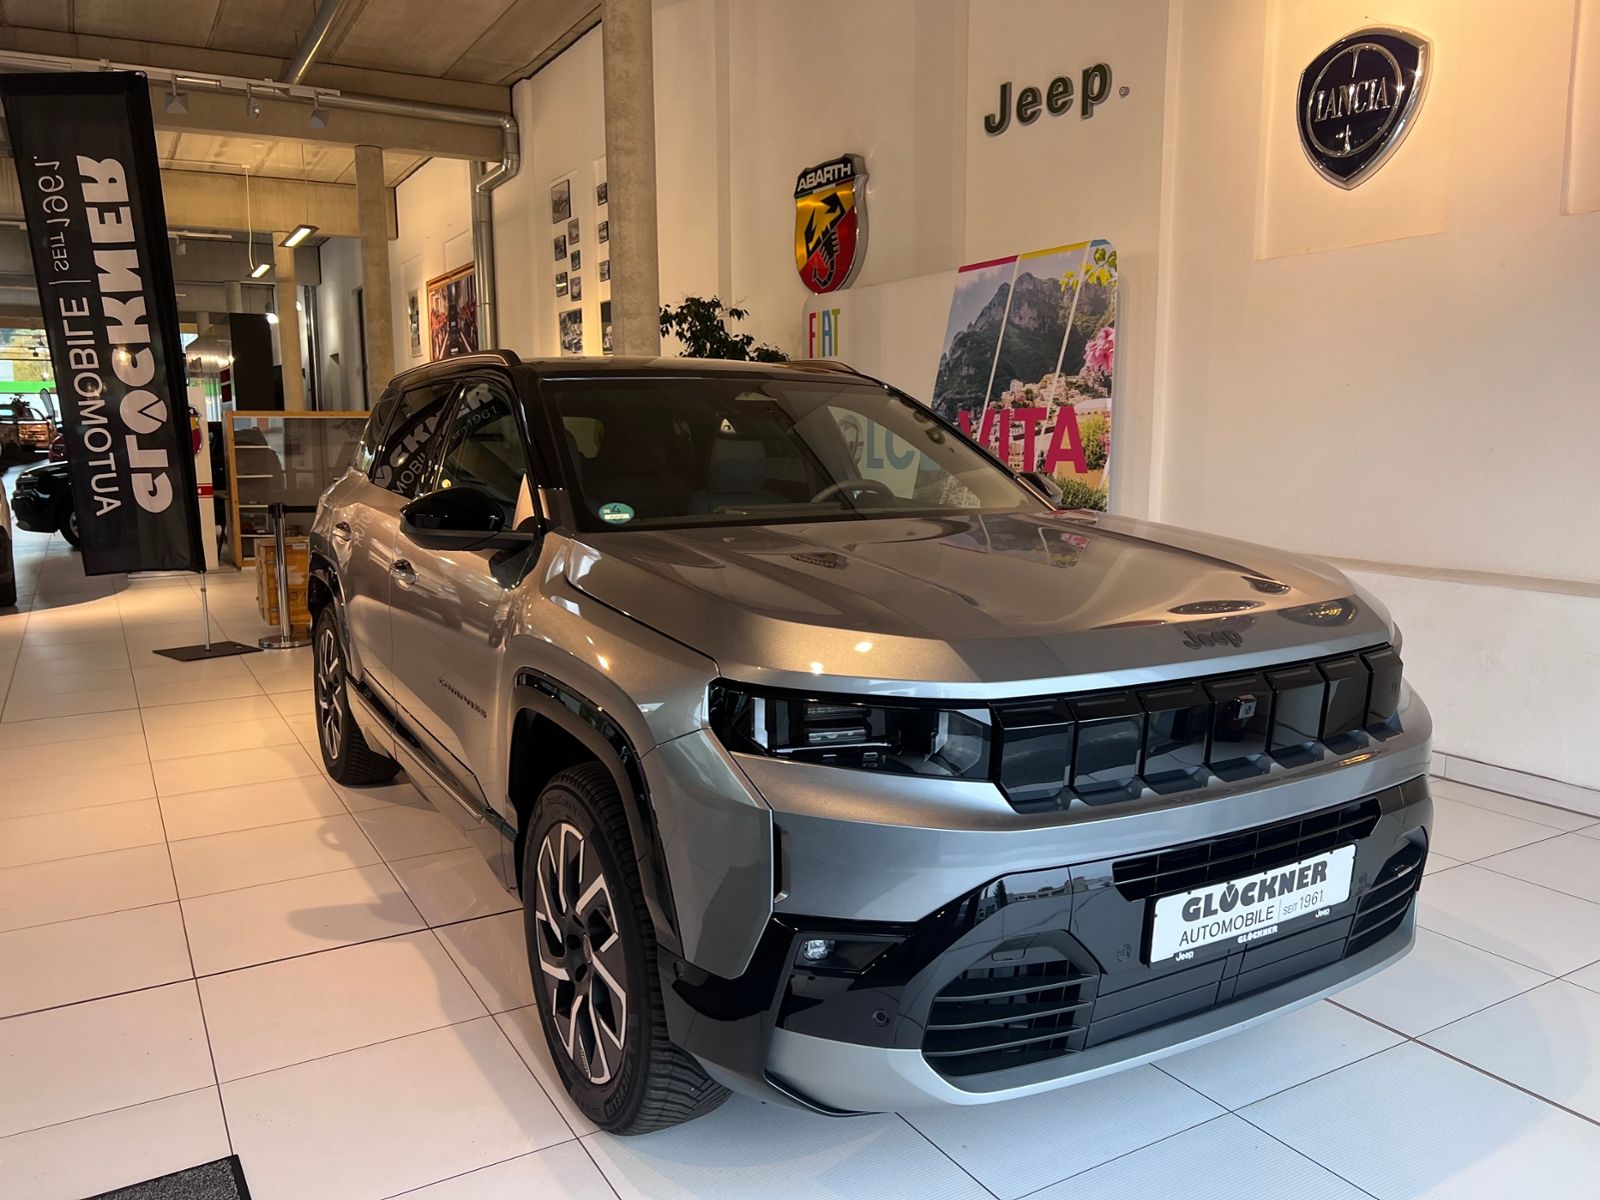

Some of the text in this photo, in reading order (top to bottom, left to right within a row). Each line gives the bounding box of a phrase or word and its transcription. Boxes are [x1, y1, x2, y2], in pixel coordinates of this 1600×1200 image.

[984, 63, 1113, 137] Jeep
[1314, 77, 1391, 122] LANCIA
[797, 163, 851, 192] ABARTH
[809, 308, 841, 359] FIAT
[958, 405, 1088, 473] VITA
[1182, 630, 1243, 649] Jeep
[1179, 905, 1275, 946] AUTOMOBILE
[1282, 902, 1298, 916] SEIT
[1175, 951, 1195, 961] Jeep
